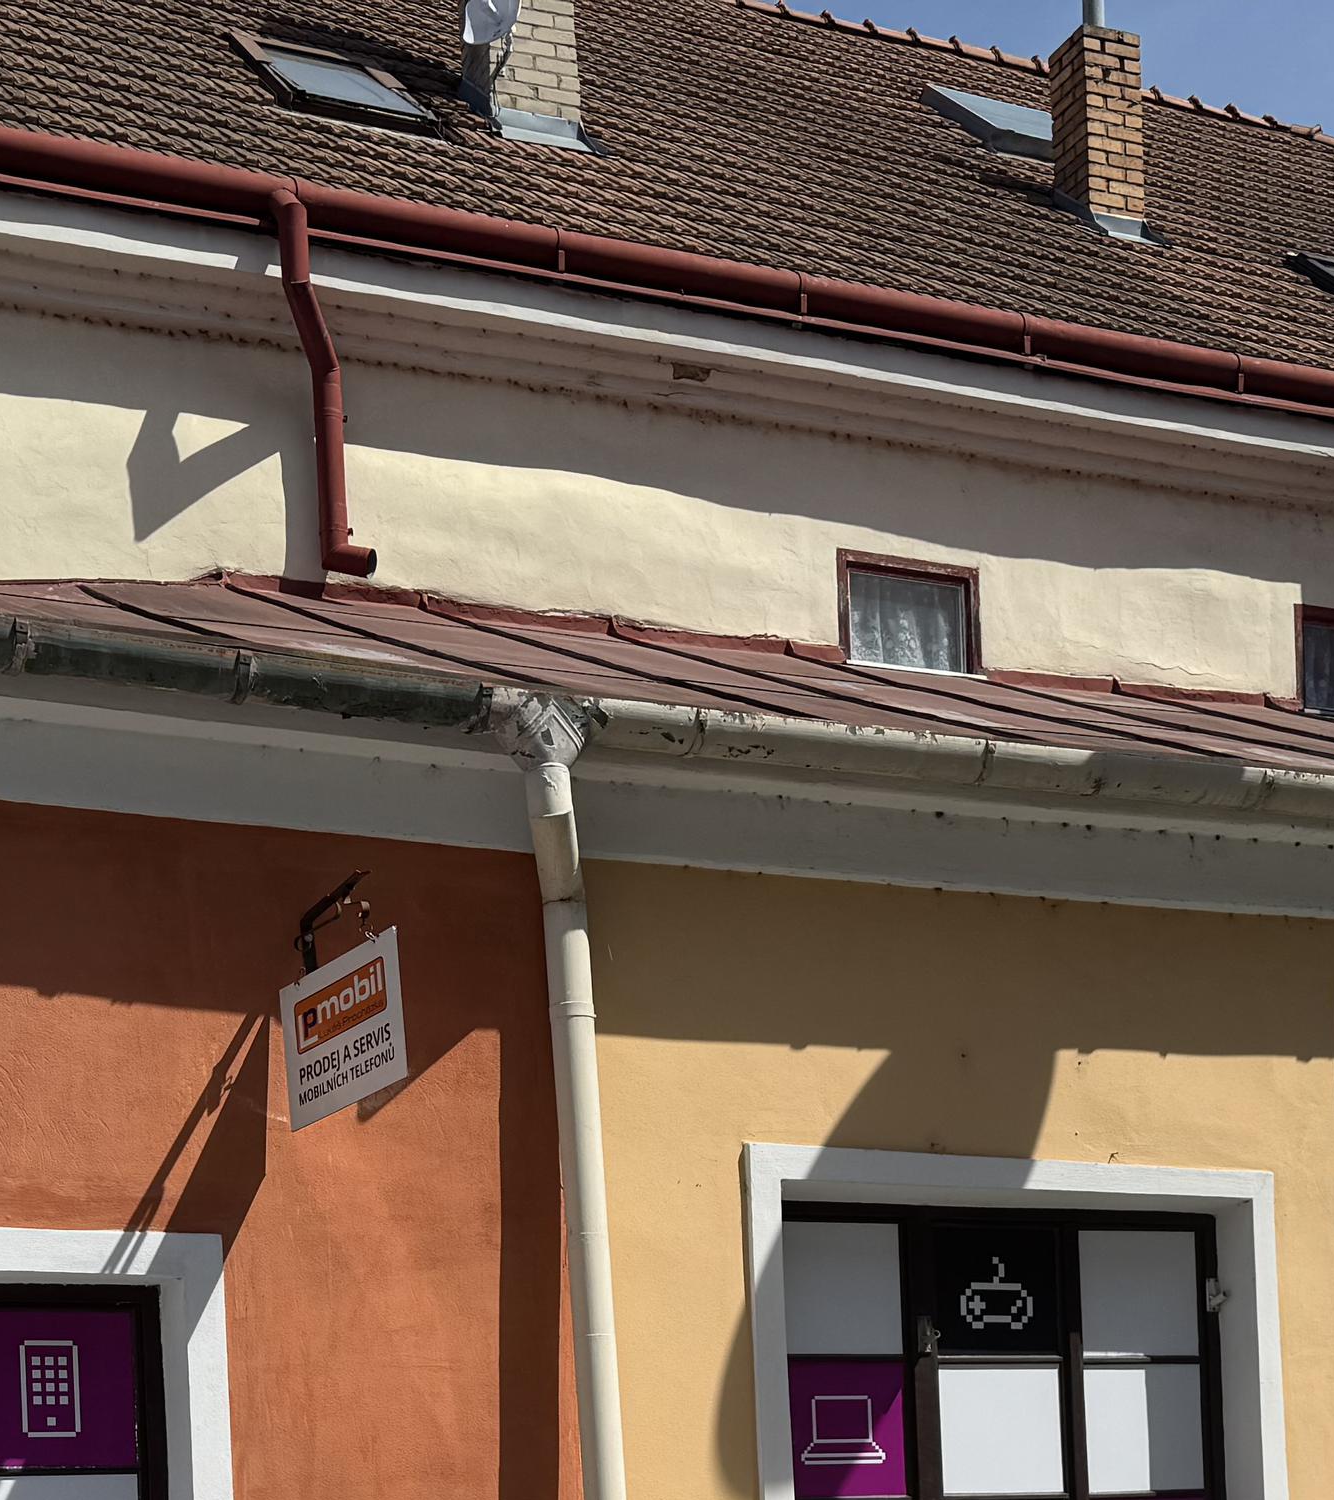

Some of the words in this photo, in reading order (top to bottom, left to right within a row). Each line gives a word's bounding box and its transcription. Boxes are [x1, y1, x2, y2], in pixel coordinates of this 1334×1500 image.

[298, 1049, 341, 1086] PRODEJ
[342, 1044, 352, 1064] A
[353, 1022, 391, 1058] SERVIS
[298, 1070, 349, 1107] MOBILNÍCH
[349, 1042, 395, 1081] TELEFONŮ
